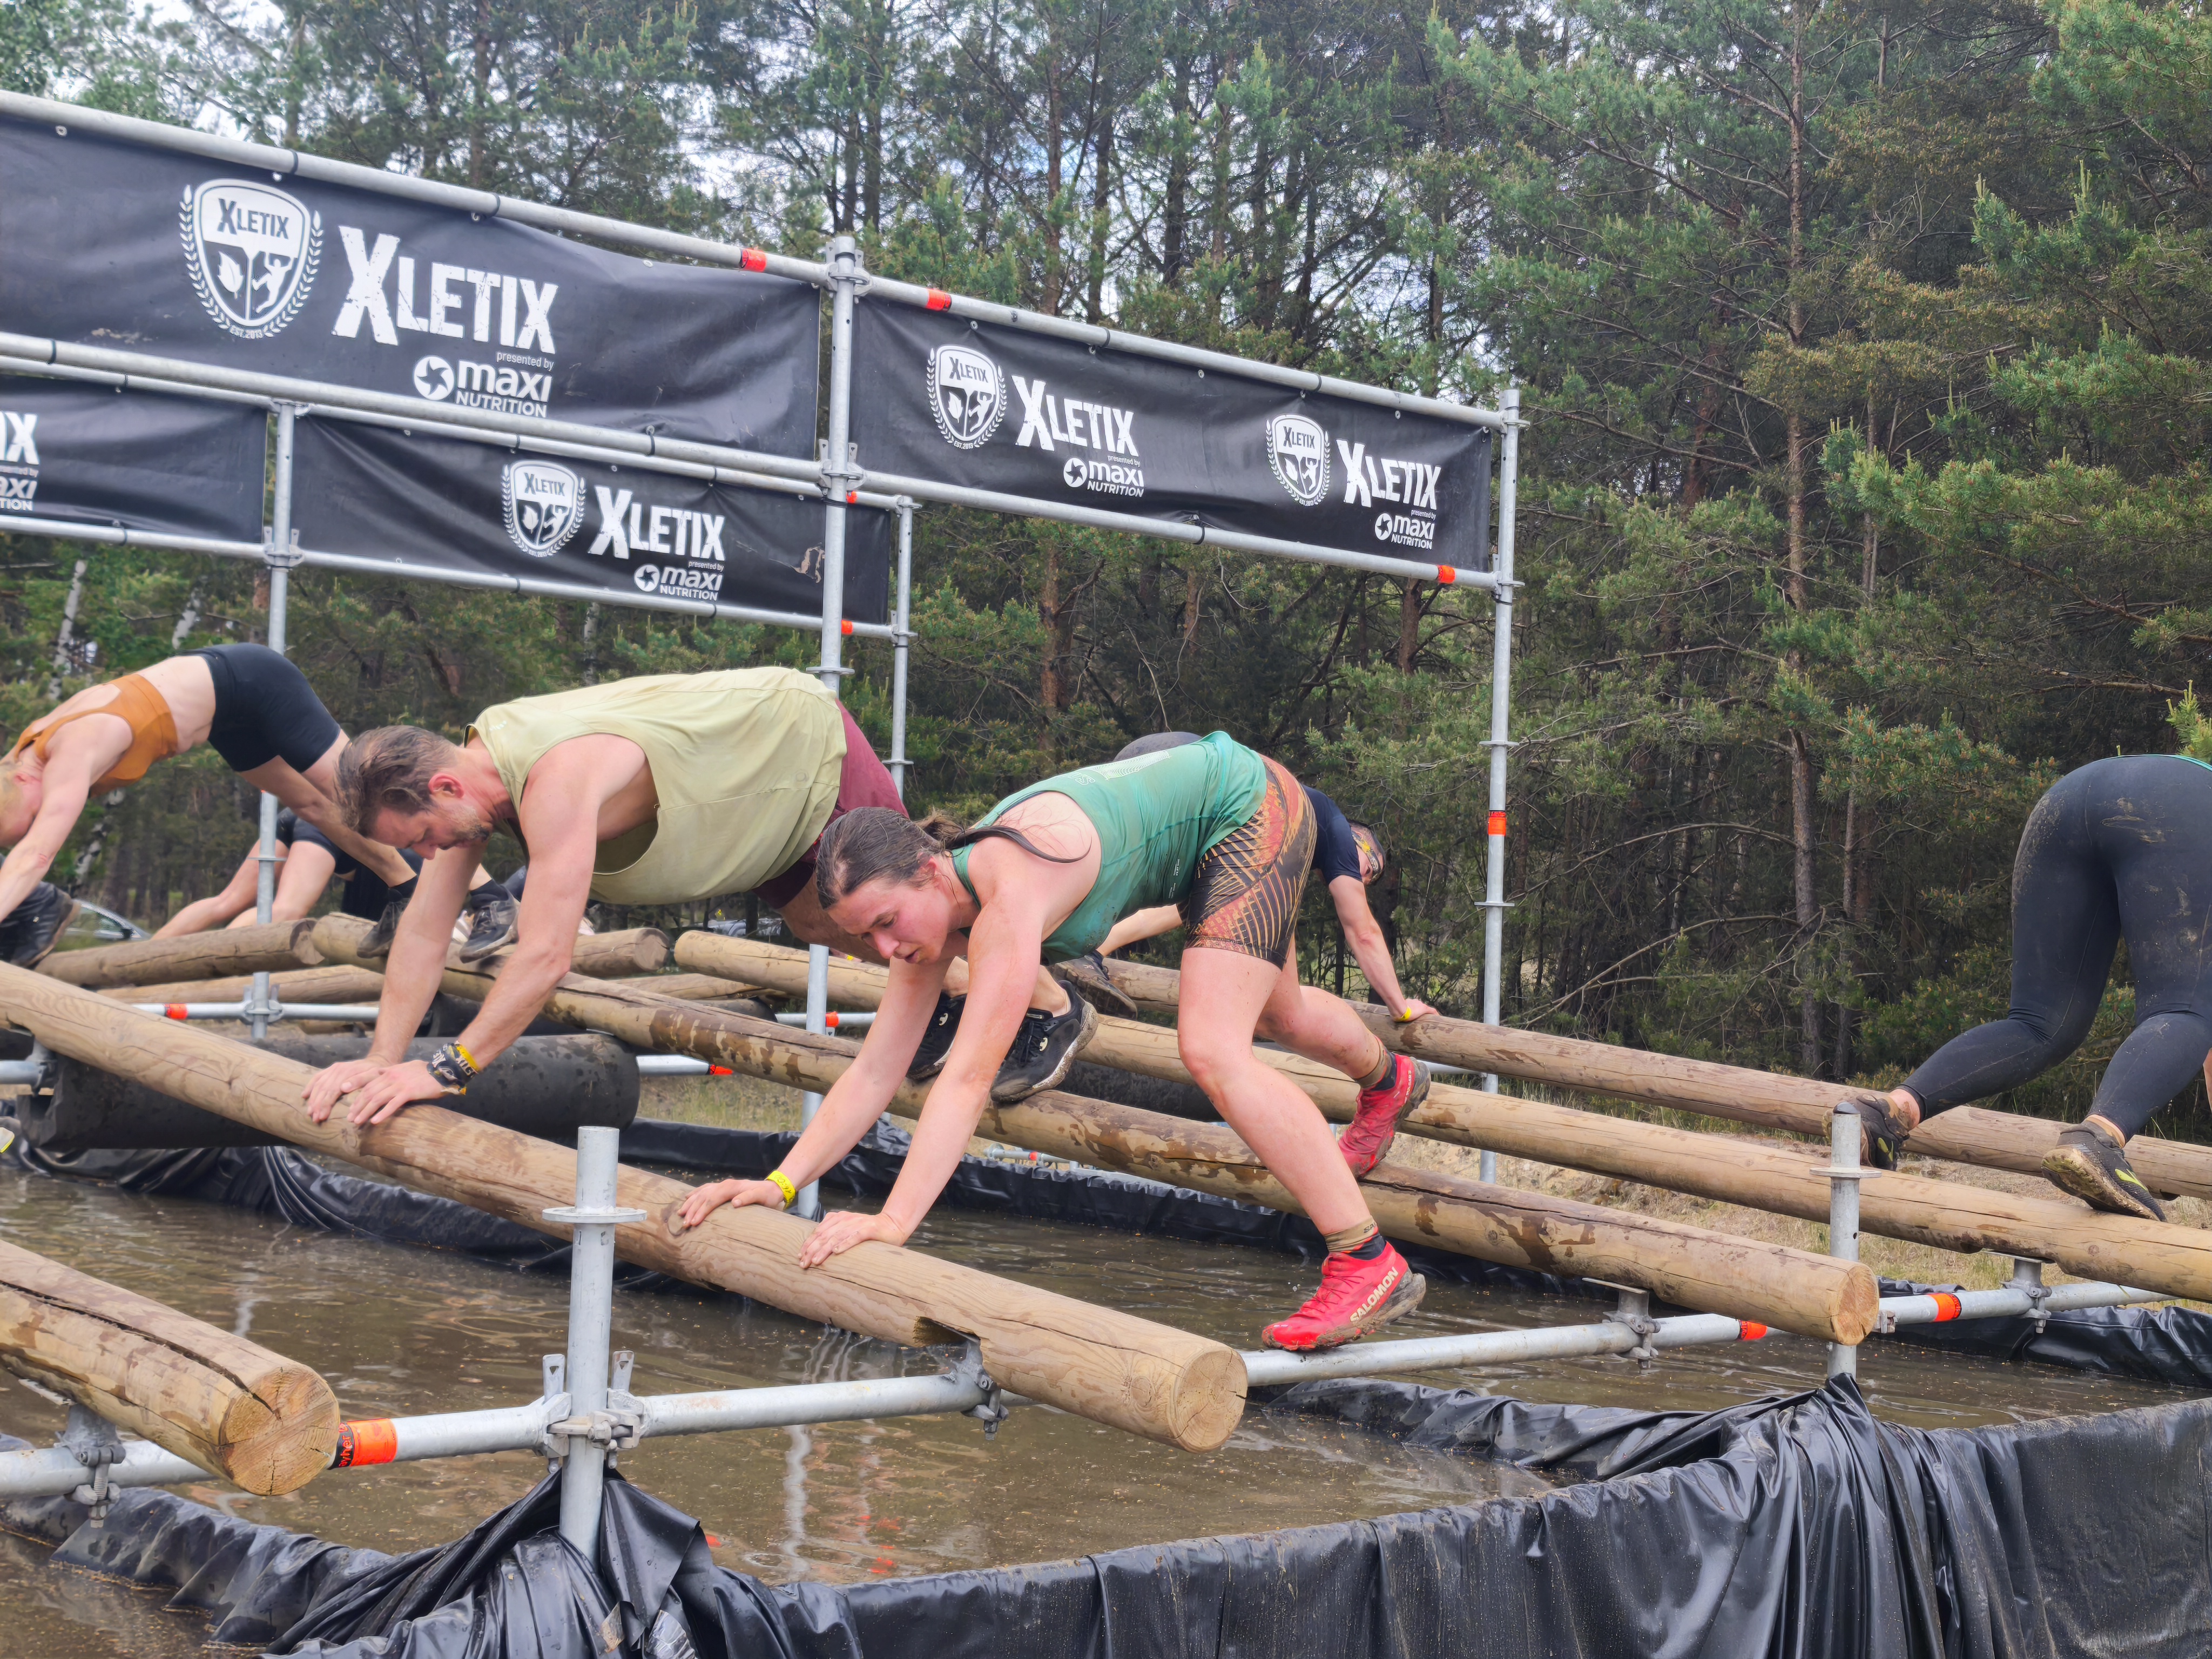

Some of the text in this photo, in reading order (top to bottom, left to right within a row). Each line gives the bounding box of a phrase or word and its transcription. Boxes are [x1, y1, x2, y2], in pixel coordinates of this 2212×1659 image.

[218, 198, 288, 239] XLETIX
[331, 225, 558, 355] XLETIX
[496, 352, 554, 372] presented by
[949, 356, 988, 383] XLETIX
[458, 360, 552, 402] maxi
[456, 390, 547, 417] NUTRITION
[1011, 375, 1138, 457] XLETIX
[1283, 426, 1315, 449] XLETIX
[1108, 455, 1140, 467] presented by
[524, 472, 565, 496] XLETIX
[1089, 461, 1144, 487] maxi
[1336, 439, 1441, 510] XLETIX
[1088, 481, 1144, 497] NUTRITION
[588, 485, 726, 561] XLETIX
[1393, 515, 1434, 539] maxi
[1411, 510, 1436, 521] presented by
[1391, 534, 1432, 550] NUTRITION
[689, 561, 724, 572] presented by
[661, 567, 723, 591] maxi
[660, 585, 718, 601] NUTRITION
[1350, 1266, 1398, 1321] SALOMON
